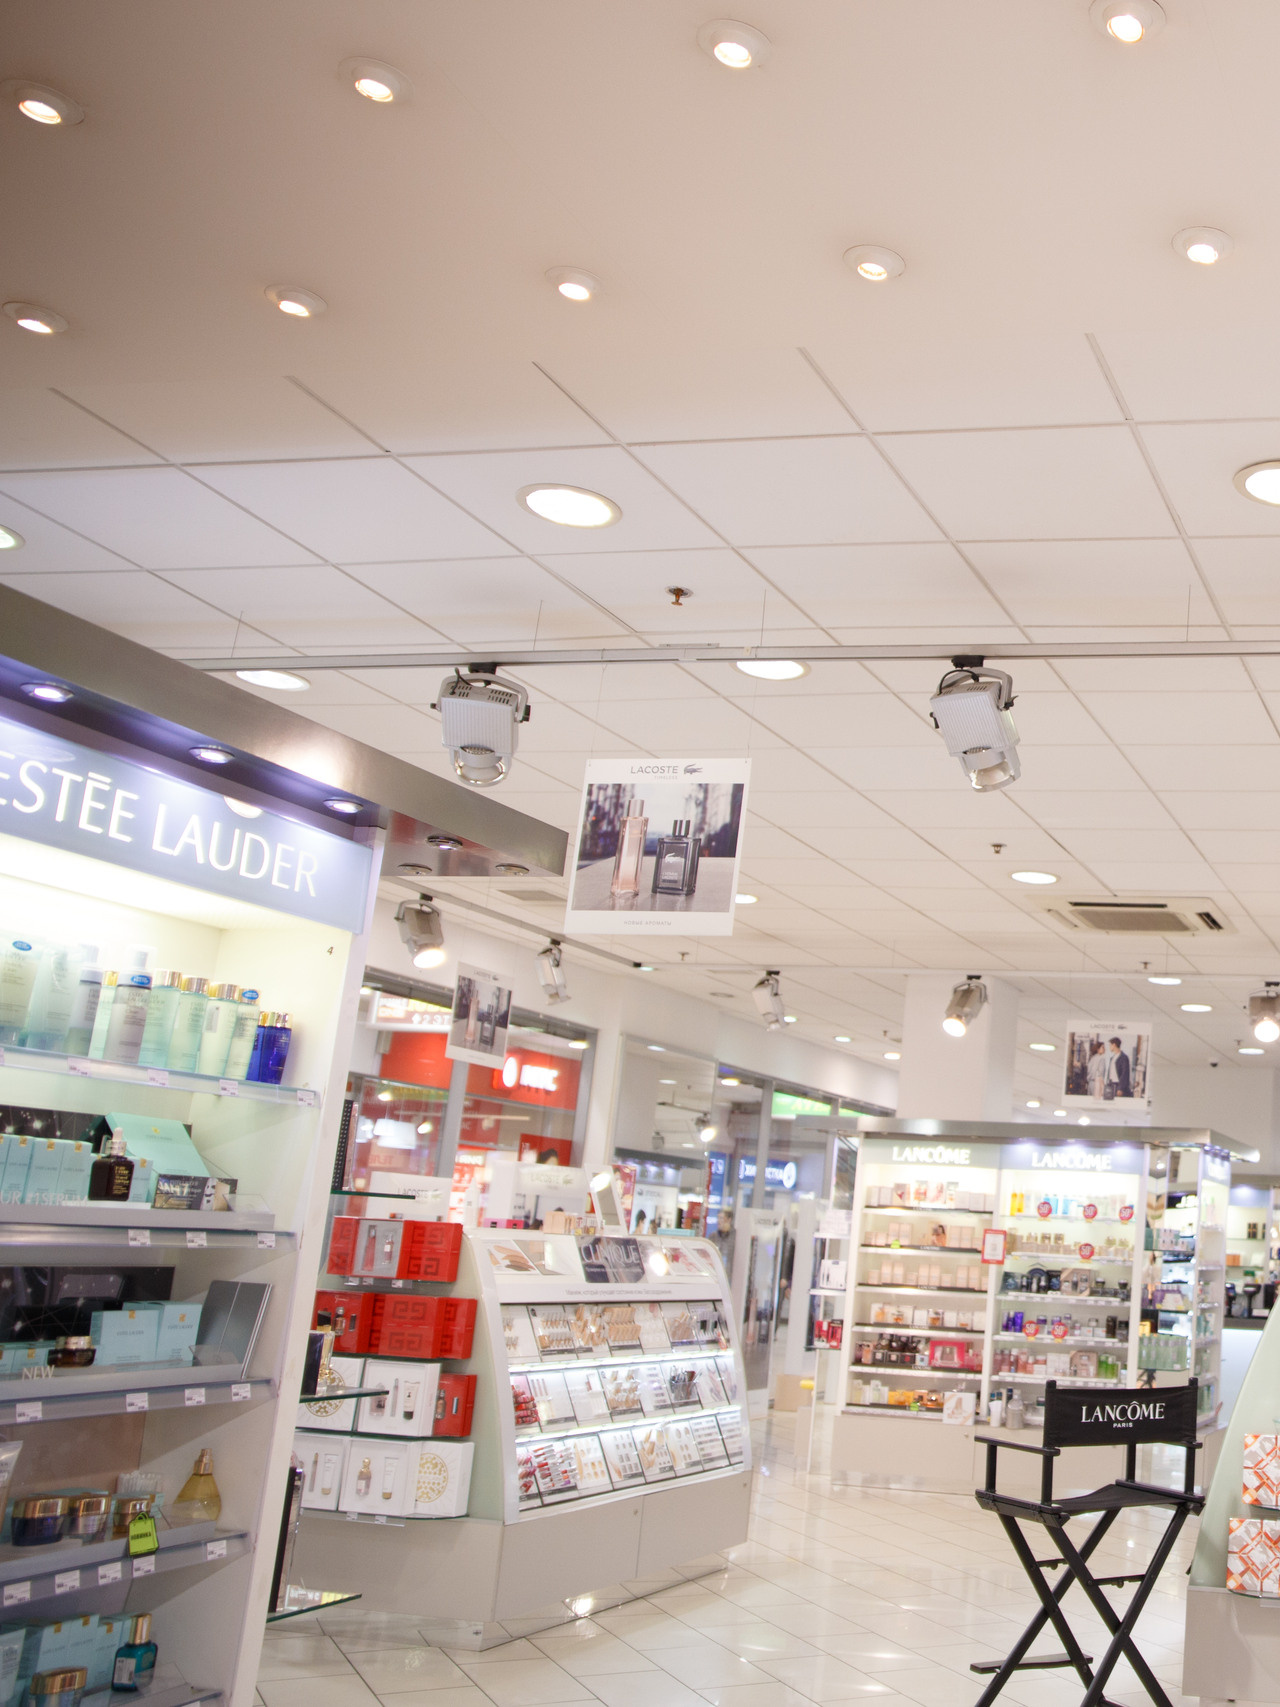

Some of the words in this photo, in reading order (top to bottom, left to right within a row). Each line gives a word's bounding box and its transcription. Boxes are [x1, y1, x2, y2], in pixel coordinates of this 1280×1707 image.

[630, 765, 679, 775] LACOSTE
[151, 803, 319, 898] LAUDER
[645, 919, 672, 927] АРОМАТЫ
[581, 1244, 640, 1266] CLINIQUE
[22, 1365, 55, 1380] NEW
[1080, 1400, 1166, 1423] LANCÔME
